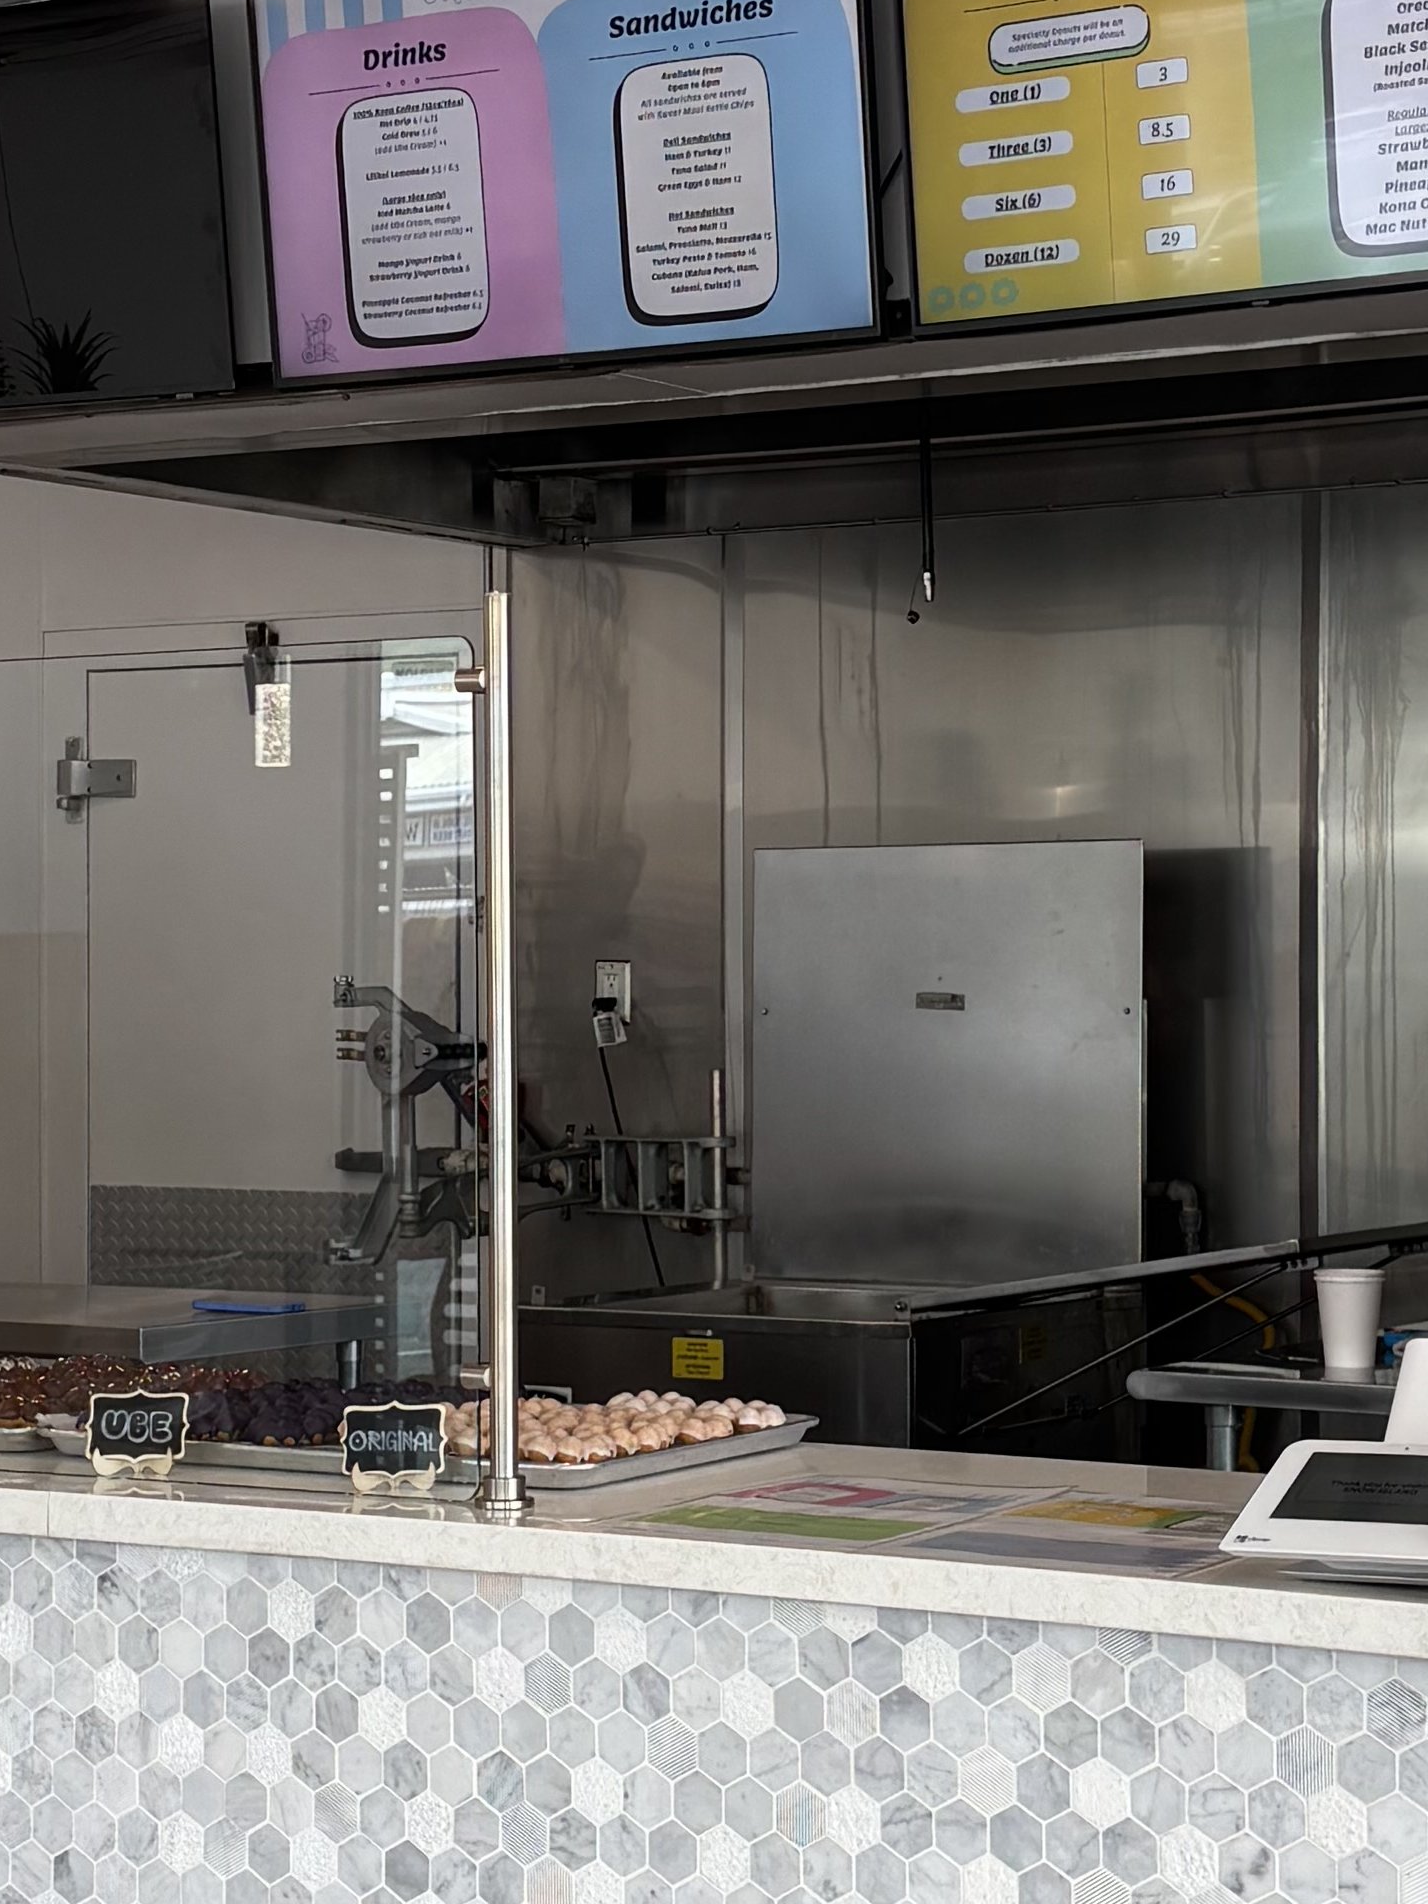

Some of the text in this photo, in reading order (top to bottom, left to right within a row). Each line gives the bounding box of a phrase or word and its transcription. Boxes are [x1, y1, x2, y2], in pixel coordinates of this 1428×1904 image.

[363, 40, 447, 71] Drinks
[1364, 43, 1406, 59] Black
[1159, 67, 1167, 82] 3
[989, 84, 1041, 105] One (1)
[1151, 122, 1173, 138] 8.5
[988, 136, 1051, 159] Three (3)
[1160, 176, 1176, 191] 16
[995, 192, 1041, 212] Six (6)
[1379, 201, 1416, 214] Kona
[1366, 223, 1396, 235] Mac
[1401, 219, 1427, 232] Nut
[1161, 231, 1180, 246] 29
[984, 245, 1060, 267] Dozen (12)
[101, 1410, 172, 1443] UBE
[348, 1430, 438, 1453] ORIGINAL
